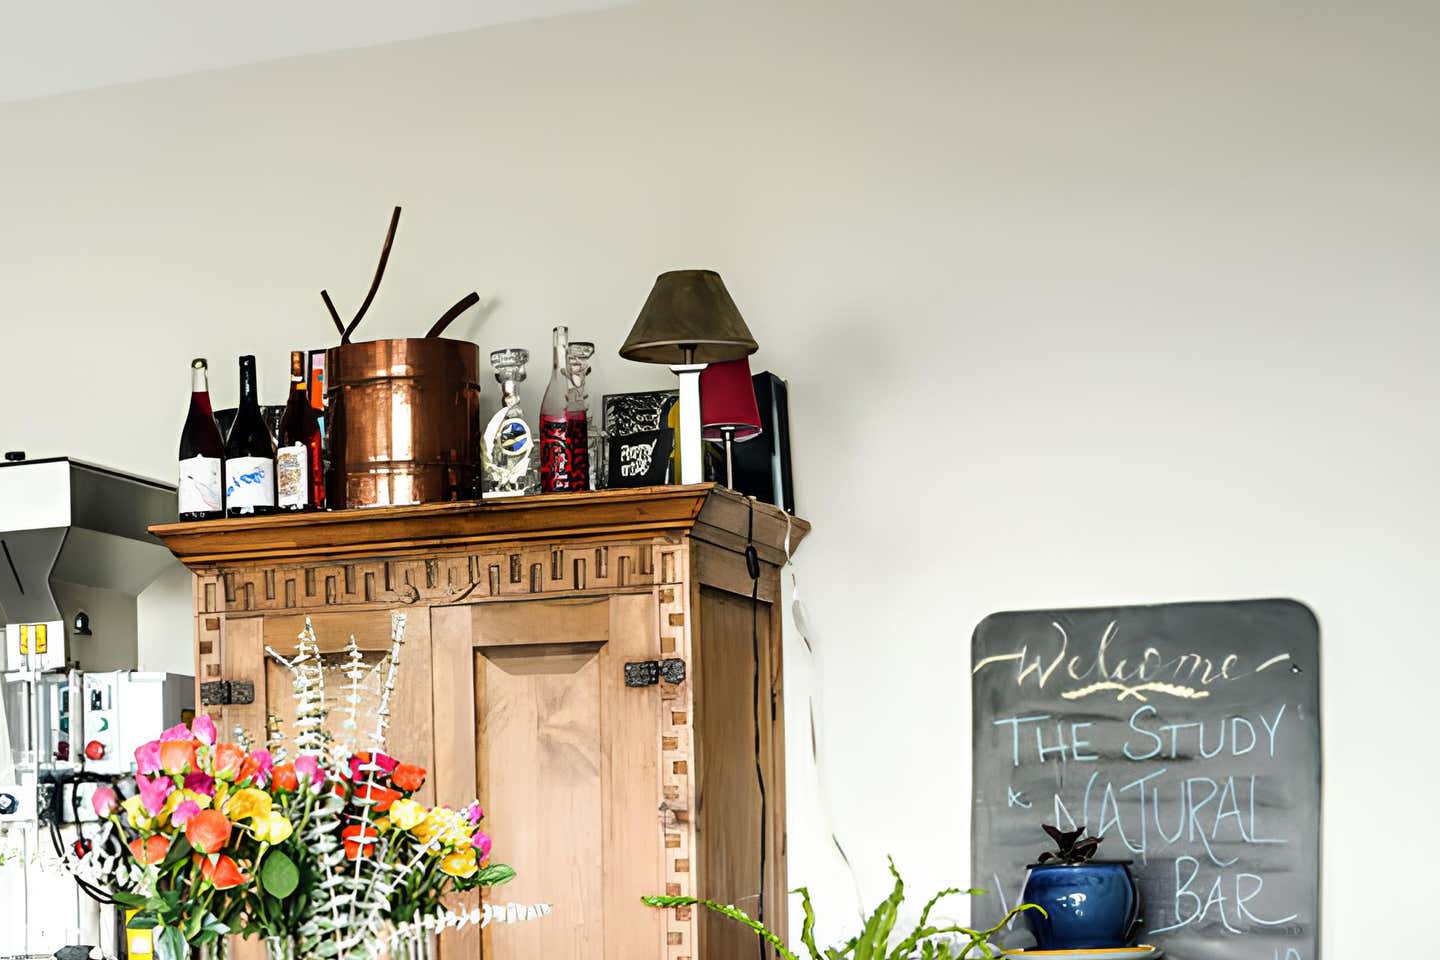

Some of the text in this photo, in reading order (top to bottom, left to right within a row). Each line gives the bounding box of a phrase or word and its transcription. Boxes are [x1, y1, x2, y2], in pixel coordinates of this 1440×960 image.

[993, 705, 1287, 767] THE STUDY
[1054, 769, 1289, 867] NATURAL
[1148, 856, 1298, 935] BAR
